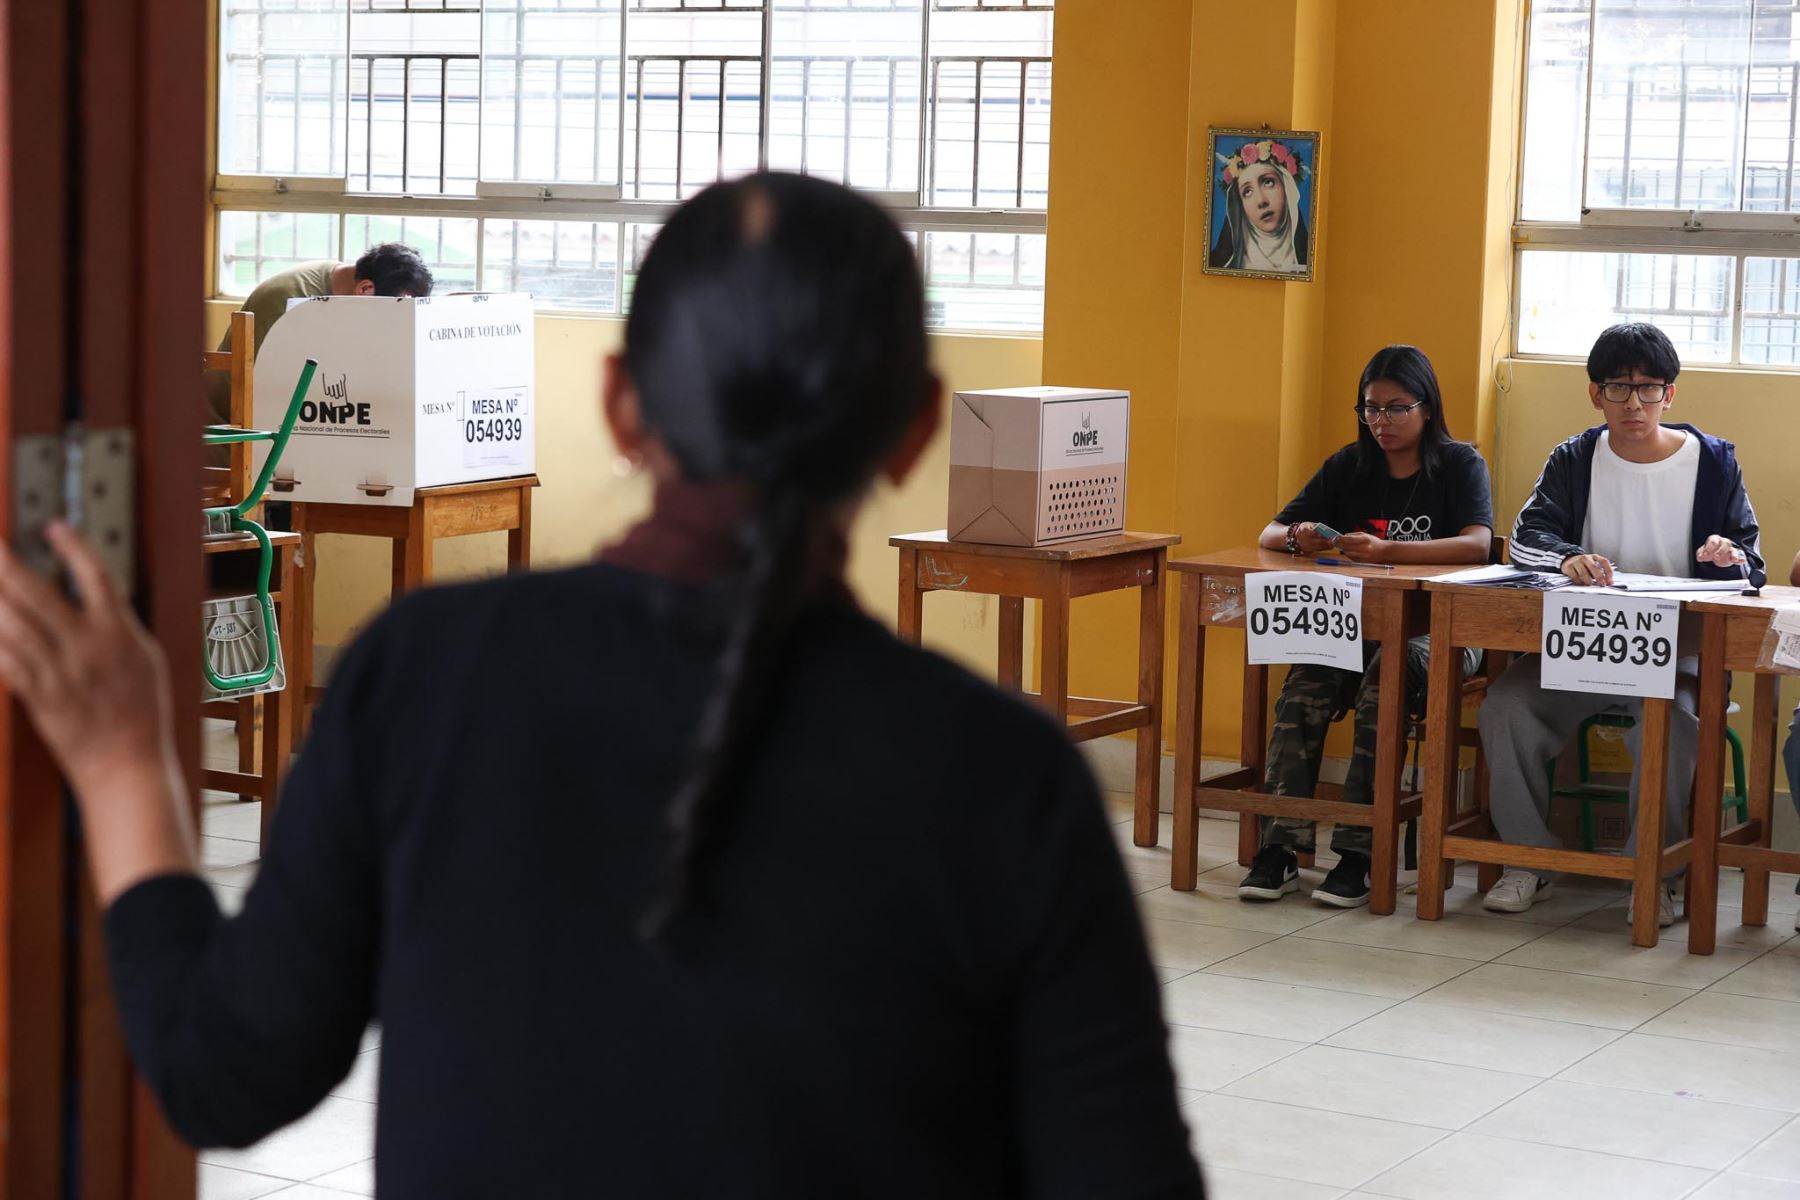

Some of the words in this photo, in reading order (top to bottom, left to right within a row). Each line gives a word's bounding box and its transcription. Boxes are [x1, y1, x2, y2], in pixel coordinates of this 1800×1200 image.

[429, 327, 463, 341] CABINA
[464, 326, 476, 339] DE
[478, 321, 521, 337] VOTACIÓN
[299, 401, 371, 425] ONPE
[422, 403, 445, 415] MESA
[472, 399, 503, 414] MESA
[466, 418, 522, 443] 054939
[1072, 430, 1098, 447] ONPE
[1264, 585, 1328, 604] MESA
[1250, 607, 1358, 641] 054939
[1561, 606, 1629, 630] MESA
[1545, 629, 1671, 667] 054939
